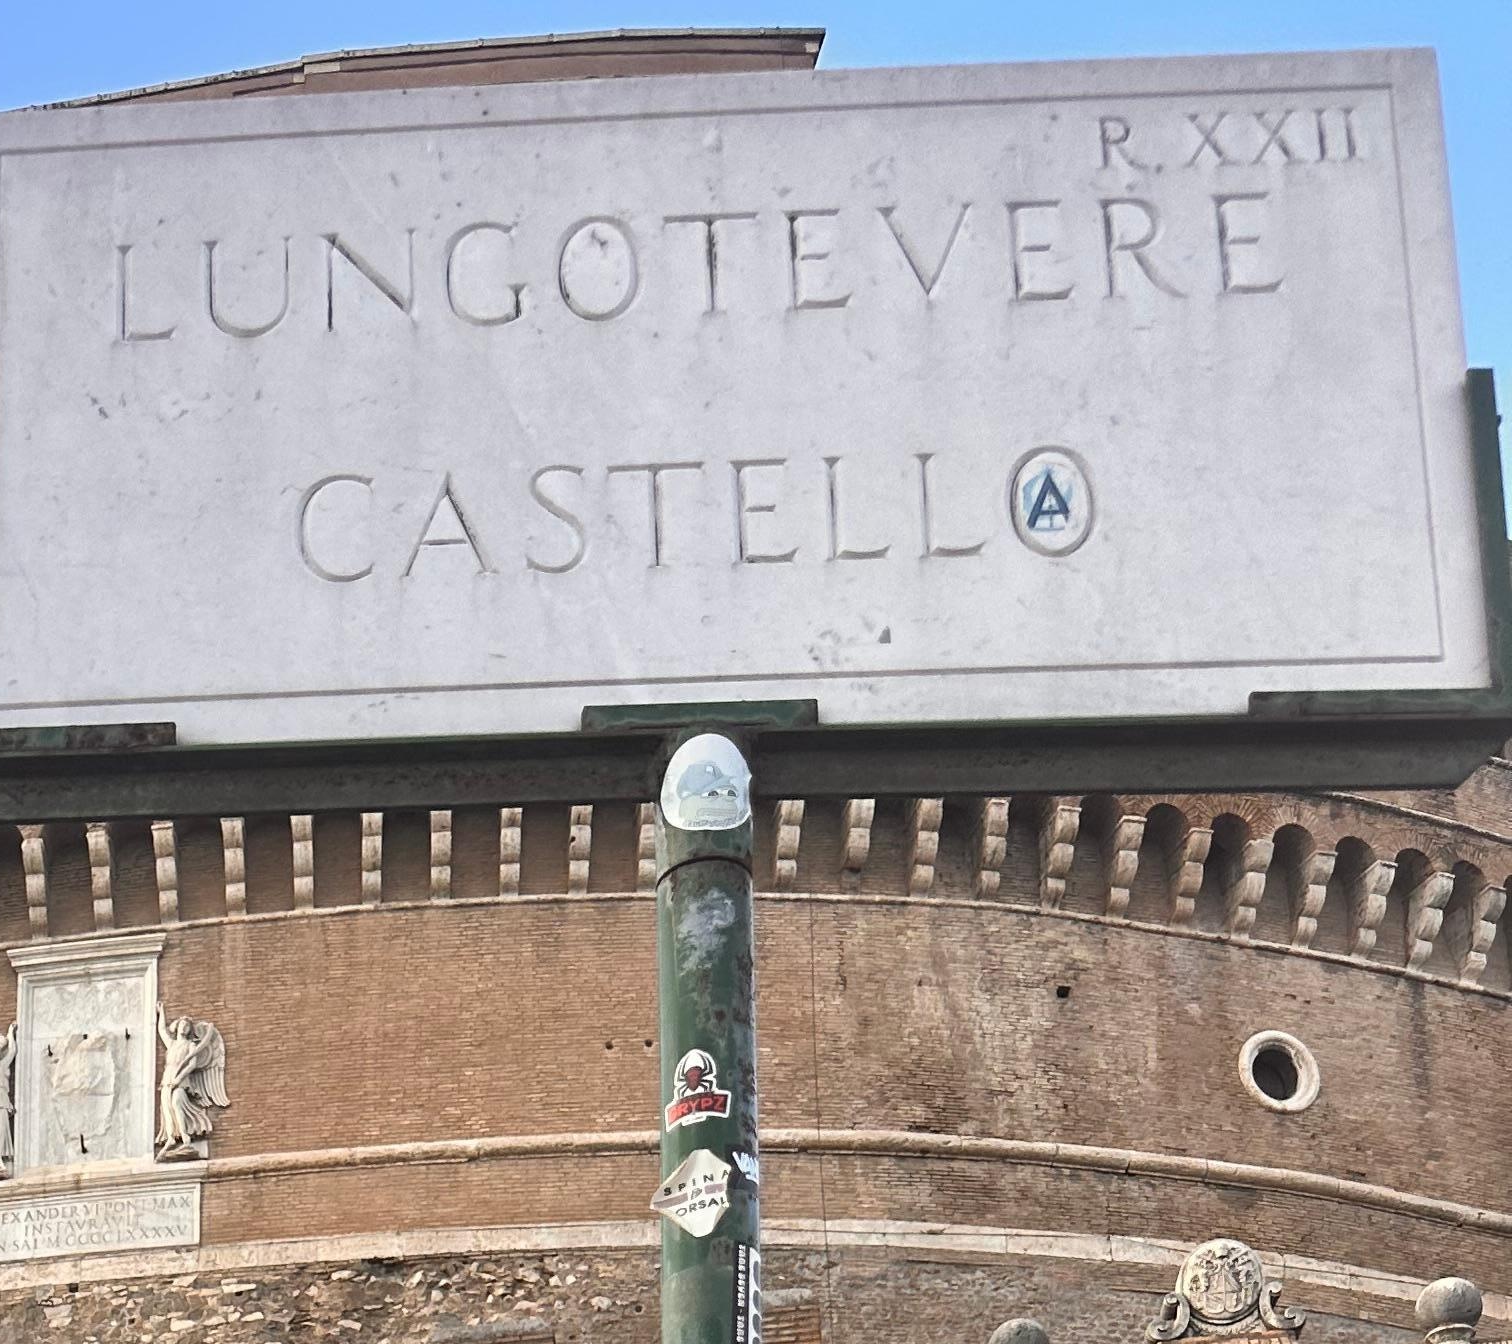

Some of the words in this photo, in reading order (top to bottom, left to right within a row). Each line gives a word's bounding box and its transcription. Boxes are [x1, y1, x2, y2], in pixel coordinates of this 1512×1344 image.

[1185, 104, 1364, 167] XXII
[110, 190, 1285, 344] LUNGOTEVERE
[296, 445, 1096, 584] CASTELLO
[663, 1169, 729, 1197] SPINA
